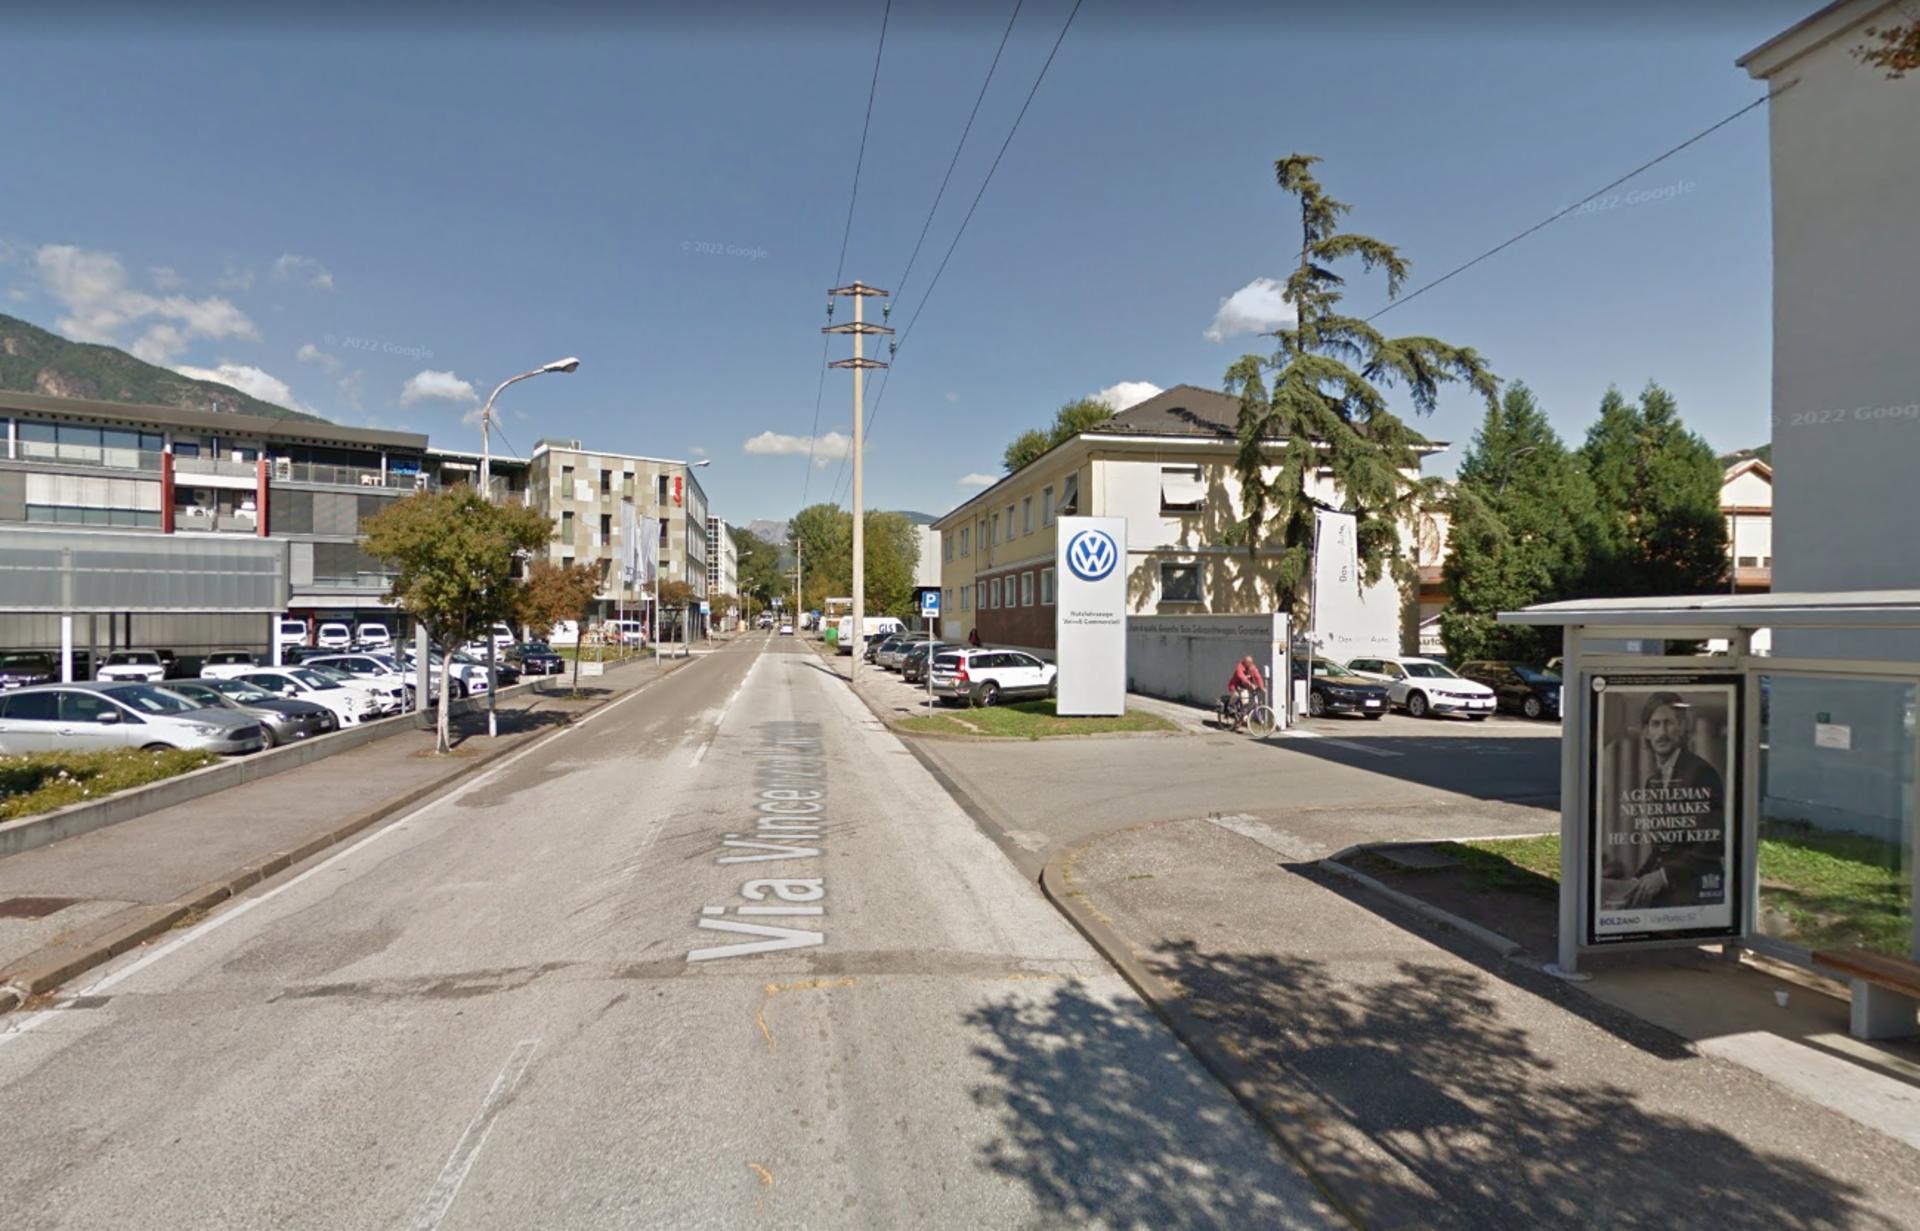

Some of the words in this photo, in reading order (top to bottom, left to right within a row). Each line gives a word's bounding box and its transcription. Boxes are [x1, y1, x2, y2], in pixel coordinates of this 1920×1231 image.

[1620, 790, 1630, 802] A
[1631, 787, 1711, 802] GENTLEMAN
[1620, 803, 1663, 816] NEVER
[1665, 801, 1711, 815] MAKES
[1634, 816, 1697, 830] PROMISES
[1608, 832, 1628, 846] HE
[1630, 830, 1686, 845] CANNOT
[1599, 916, 1641, 926] BOLZANO
